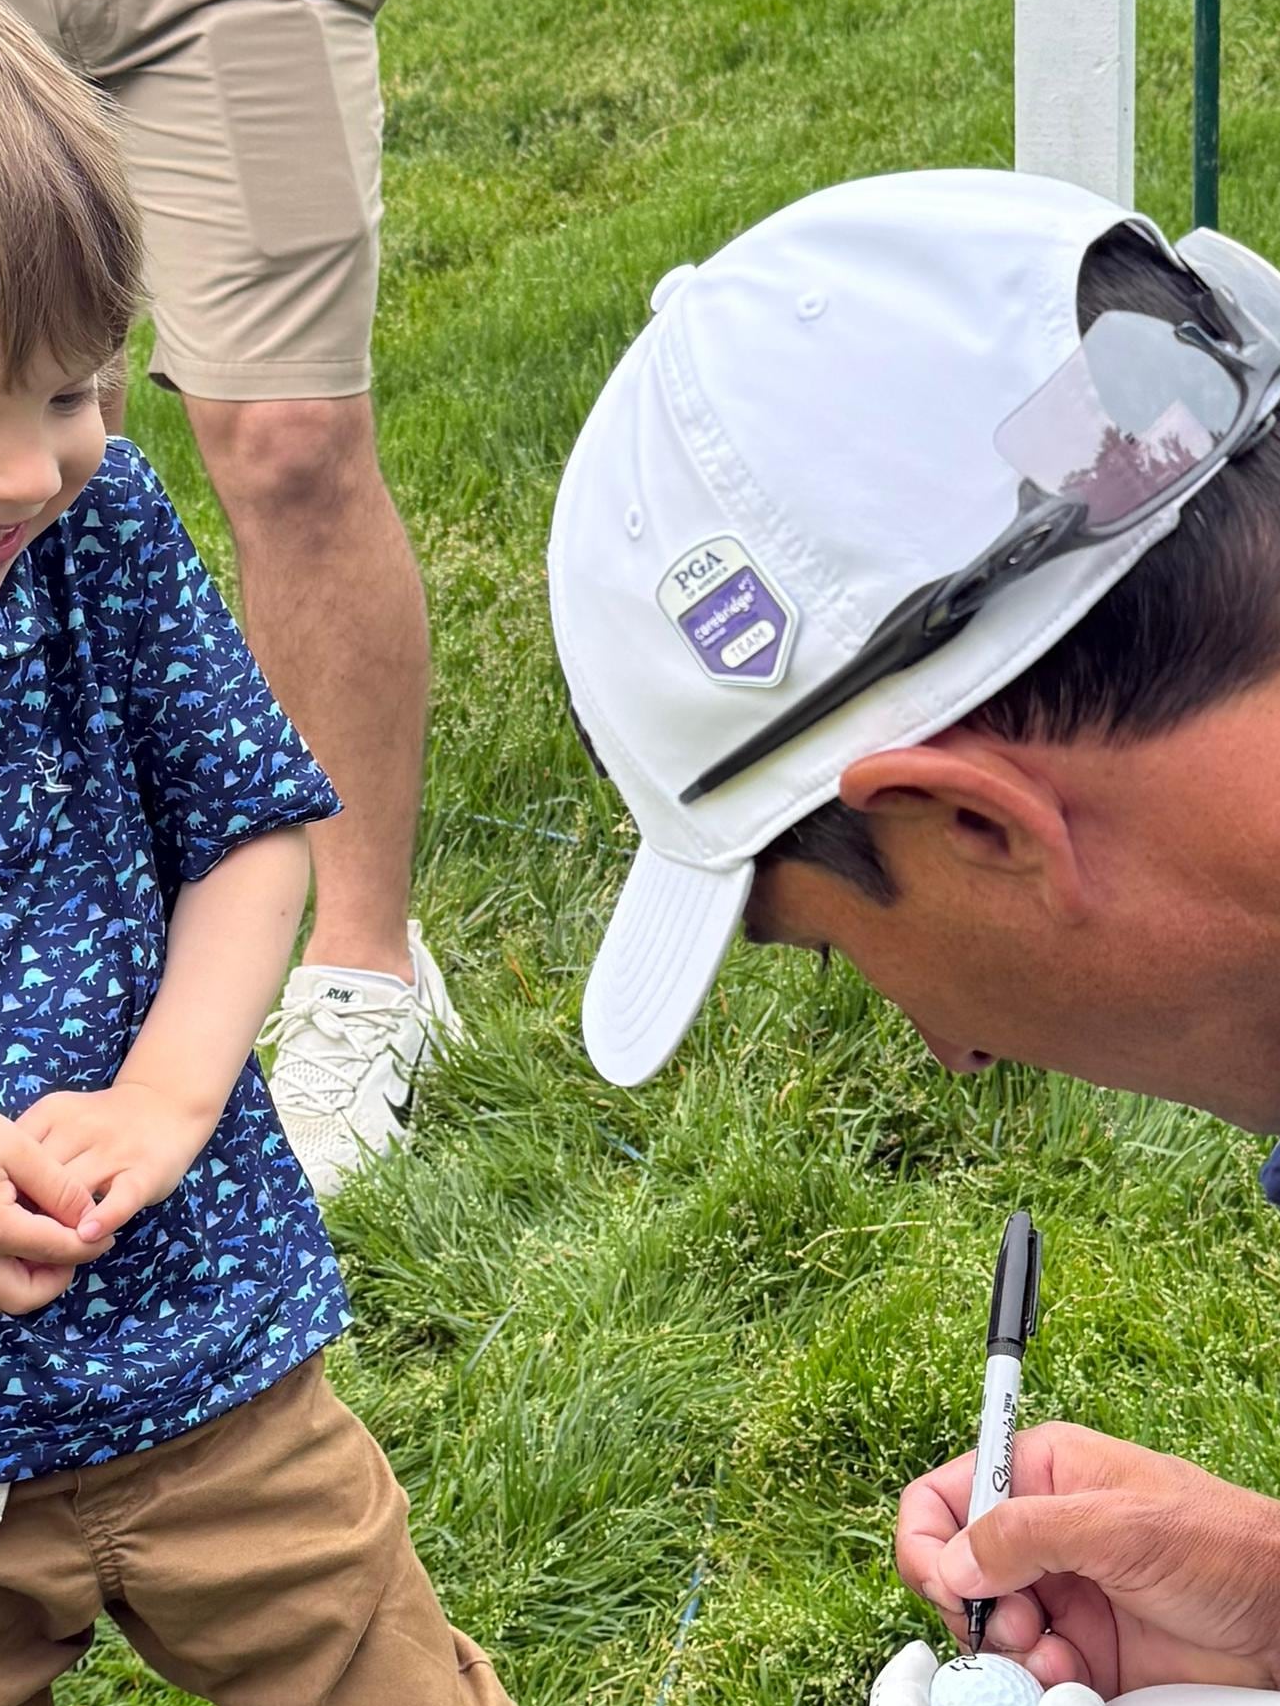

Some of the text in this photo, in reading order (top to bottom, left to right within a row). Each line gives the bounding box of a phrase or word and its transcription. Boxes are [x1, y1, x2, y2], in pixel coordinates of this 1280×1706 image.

[672, 550, 724, 592] PGA
[693, 590, 756, 641] corebridge
[730, 627, 768, 659] TEAM
[325, 987, 353, 1003] RUN
